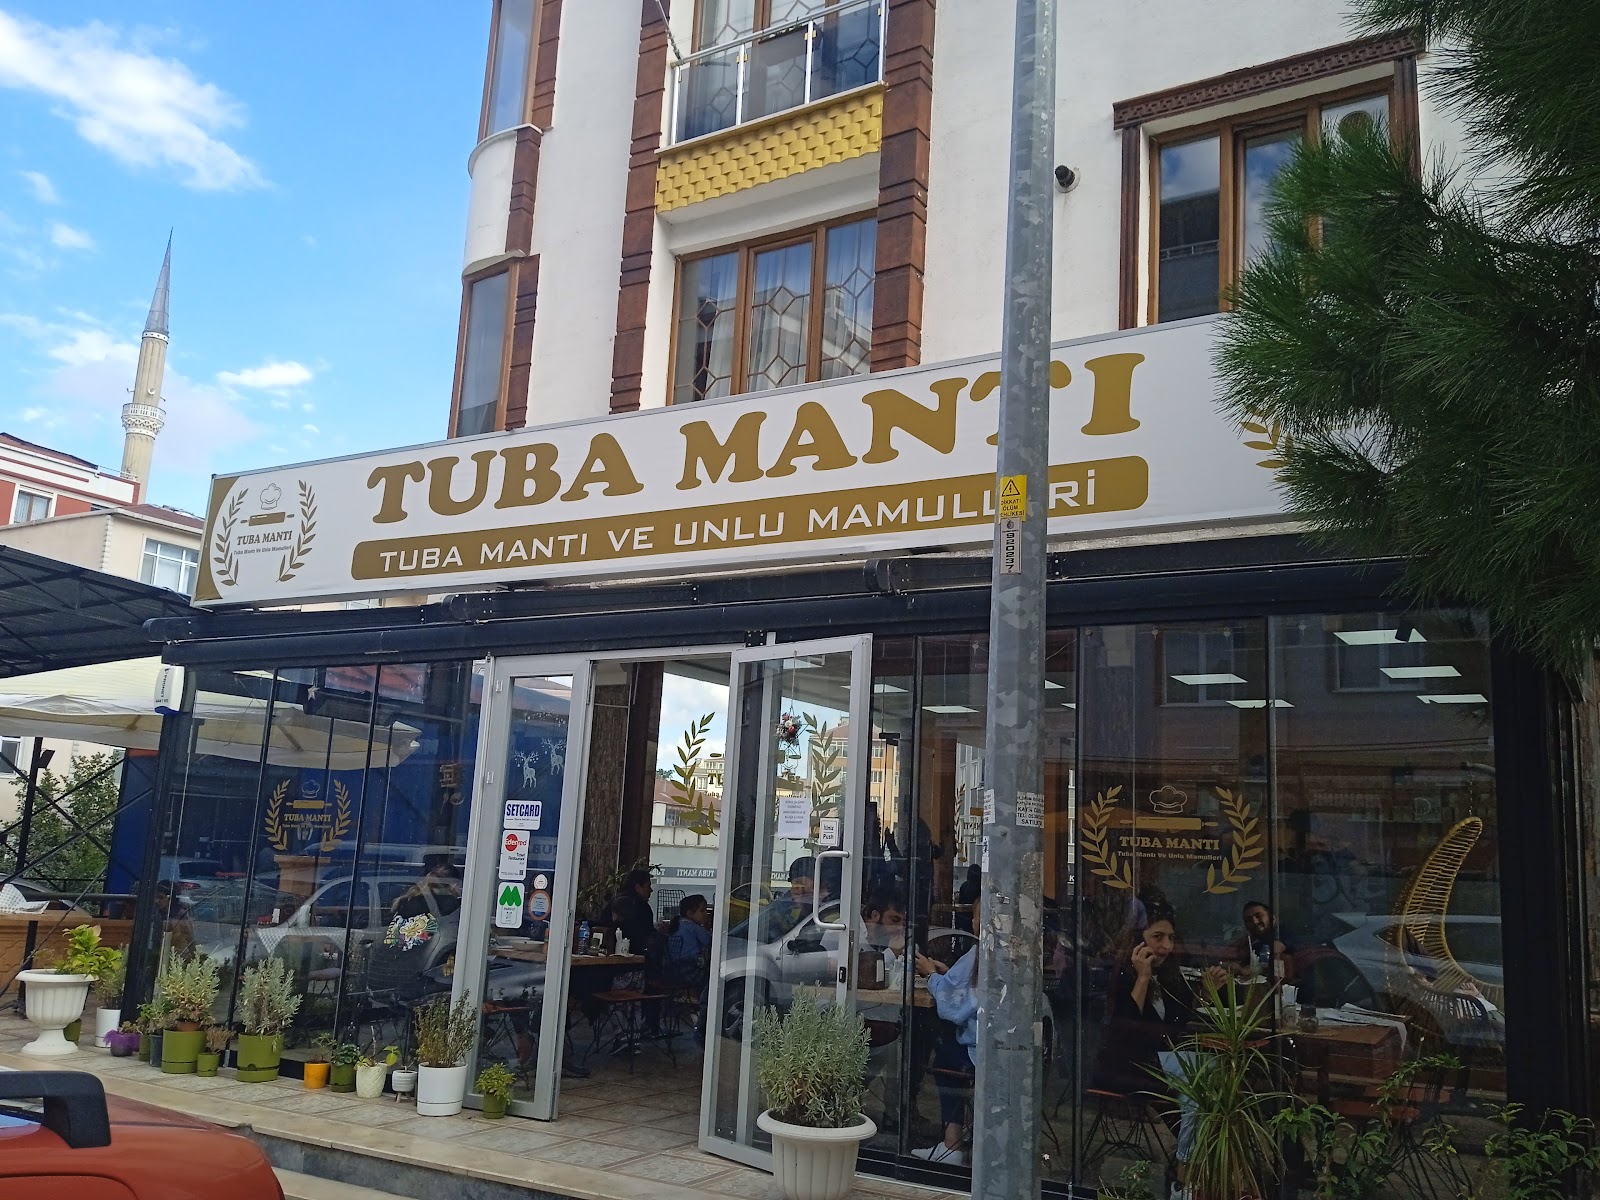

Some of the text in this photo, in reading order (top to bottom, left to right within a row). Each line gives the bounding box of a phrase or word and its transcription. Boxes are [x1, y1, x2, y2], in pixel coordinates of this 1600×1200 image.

[367, 432, 645, 524] TUBA
[379, 468, 1096, 572] TUBA MANTI VE UNLU MAMULLRİ
[236, 530, 293, 545] TUBA MANTI
[506, 803, 540, 817] SETCARD
[505, 838, 527, 846] Edenred
[1119, 836, 1220, 850] TUBA MANTI
